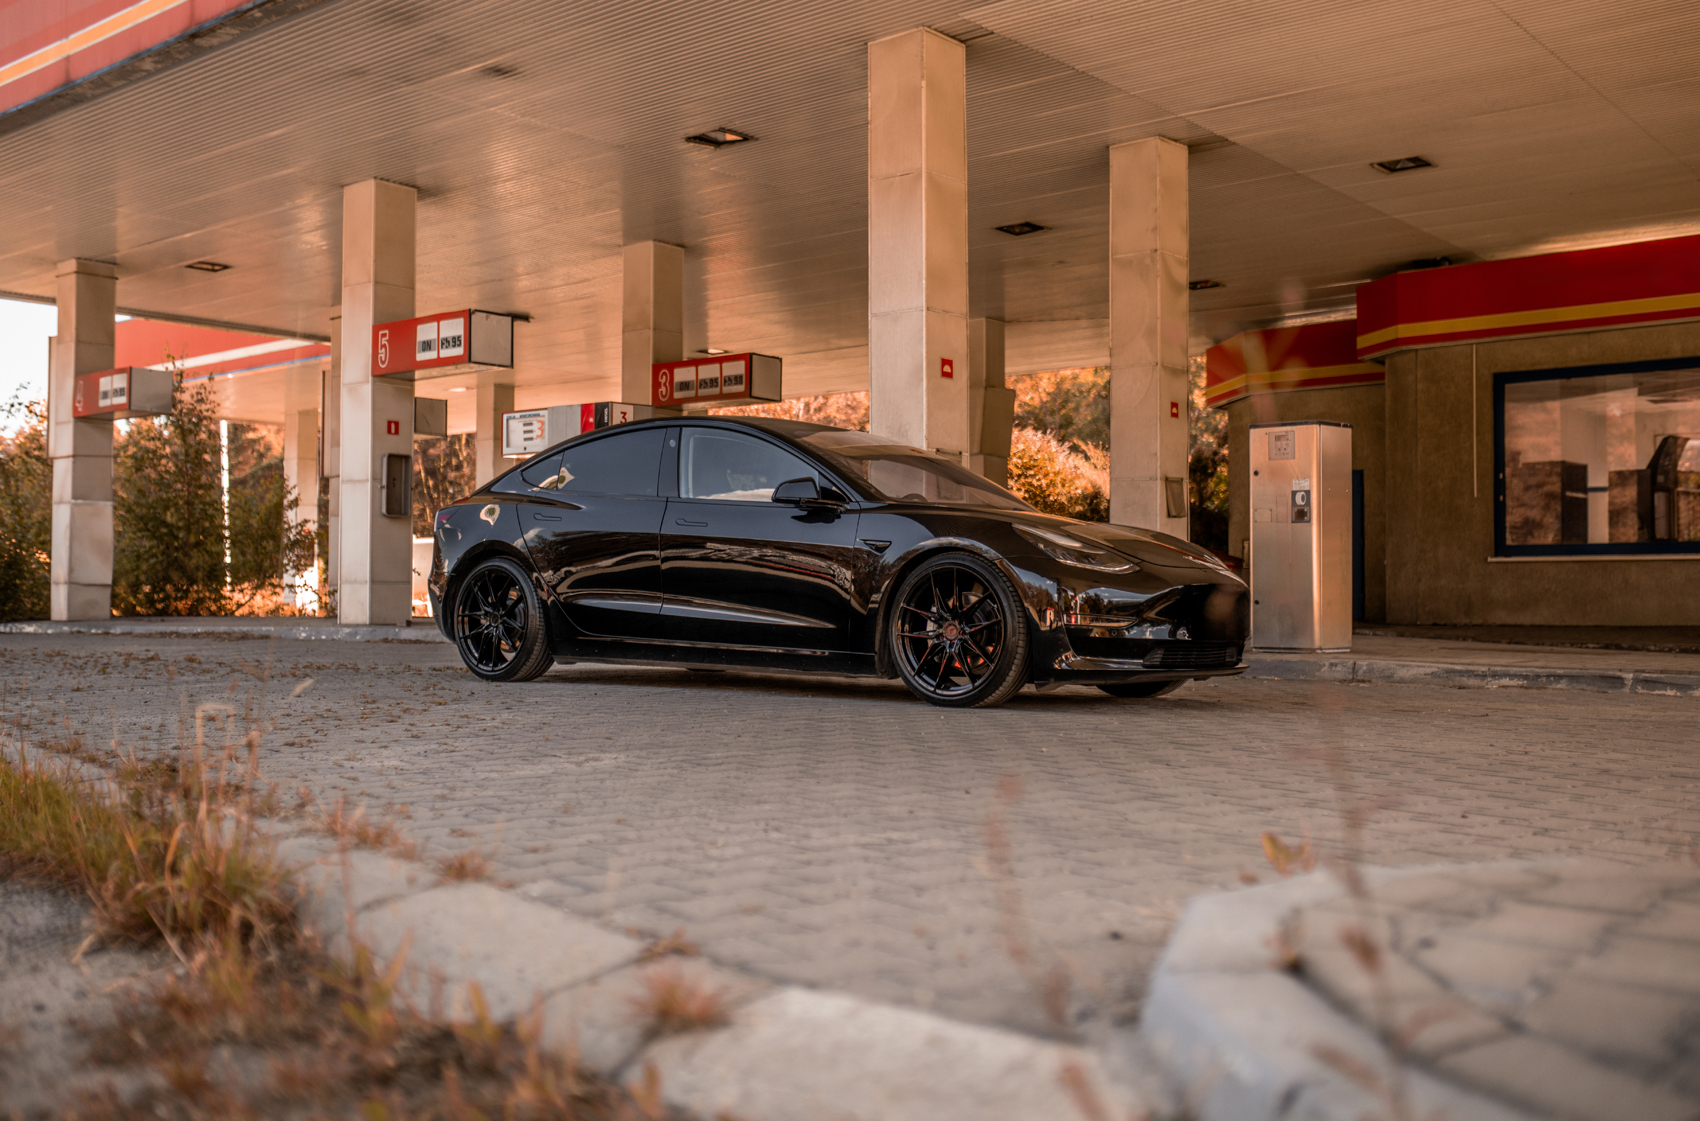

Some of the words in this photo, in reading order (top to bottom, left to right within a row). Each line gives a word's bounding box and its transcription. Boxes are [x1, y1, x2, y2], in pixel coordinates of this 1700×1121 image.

[378, 329, 389, 368] 5
[422, 340, 432, 352] ON
[658, 369, 670, 401] 3
[679, 381, 690, 392] ON
[620, 411, 628, 424] 3
[536, 420, 544, 439] 3
